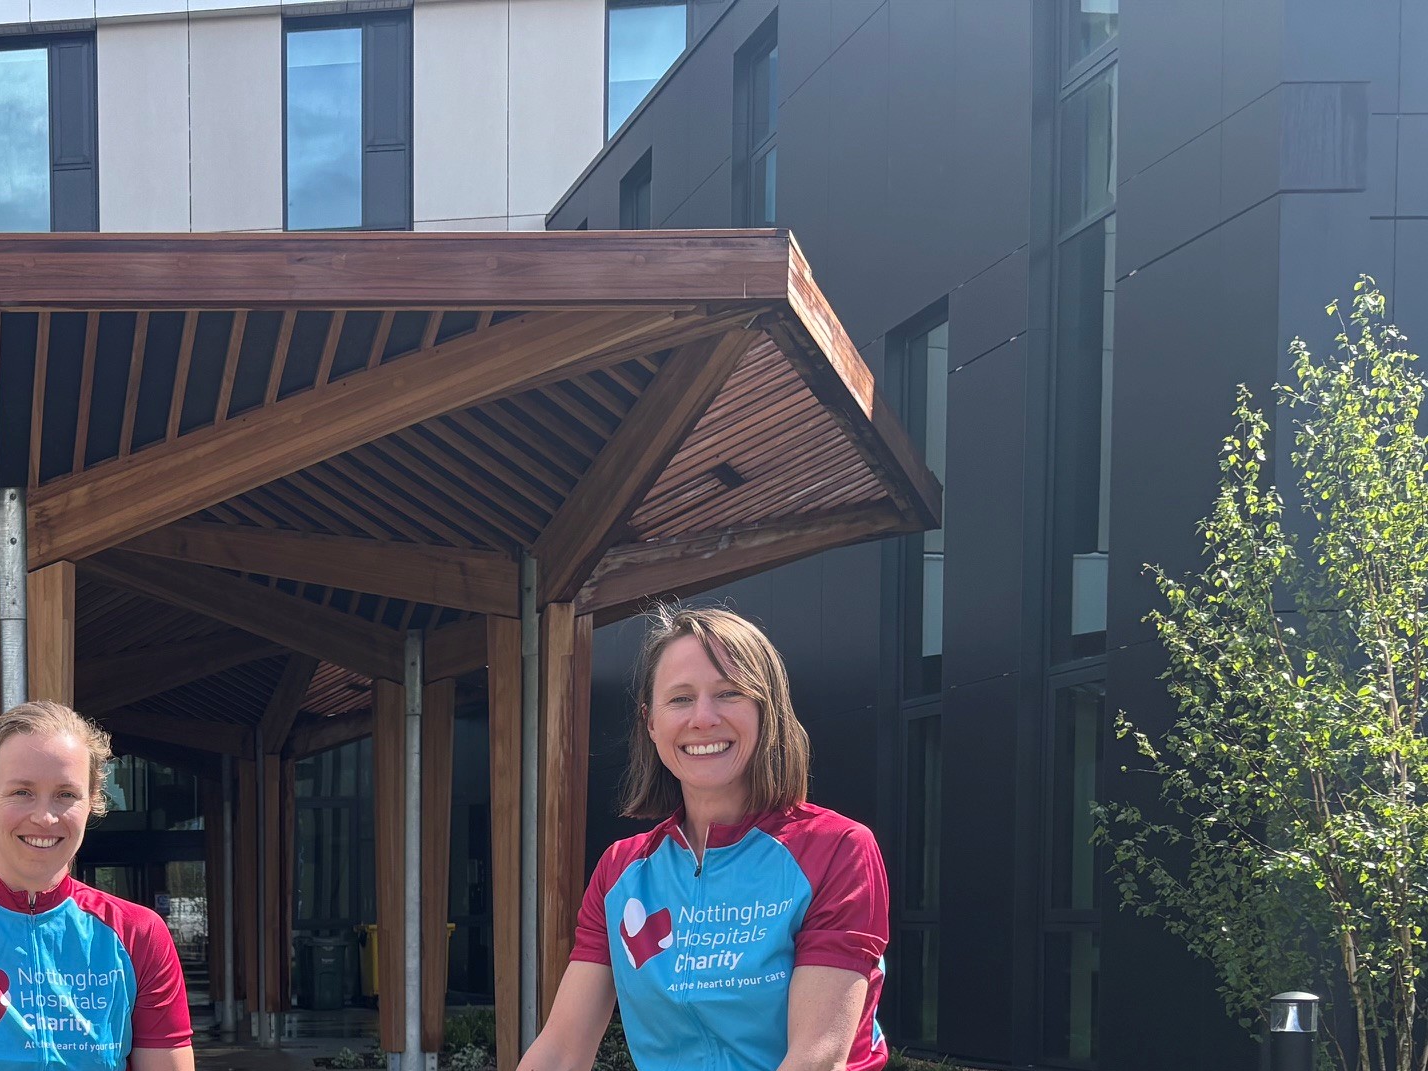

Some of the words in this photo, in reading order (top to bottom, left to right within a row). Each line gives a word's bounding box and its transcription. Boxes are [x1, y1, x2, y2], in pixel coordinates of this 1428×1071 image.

[678, 897, 793, 926] Nottingham
[676, 925, 768, 950] Hospitals
[674, 949, 744, 974] Charity
[17, 967, 125, 991] Nottingham
[666, 983, 679, 992] At
[696, 978, 723, 990] heart
[725, 977, 736, 987] of
[737, 975, 762, 987] your
[764, 970, 786, 983] care
[20, 991, 108, 1014] Hospitals
[23, 1013, 92, 1036] Charity
[79, 1041, 88, 1051] of
[90, 1043, 108, 1053] your
